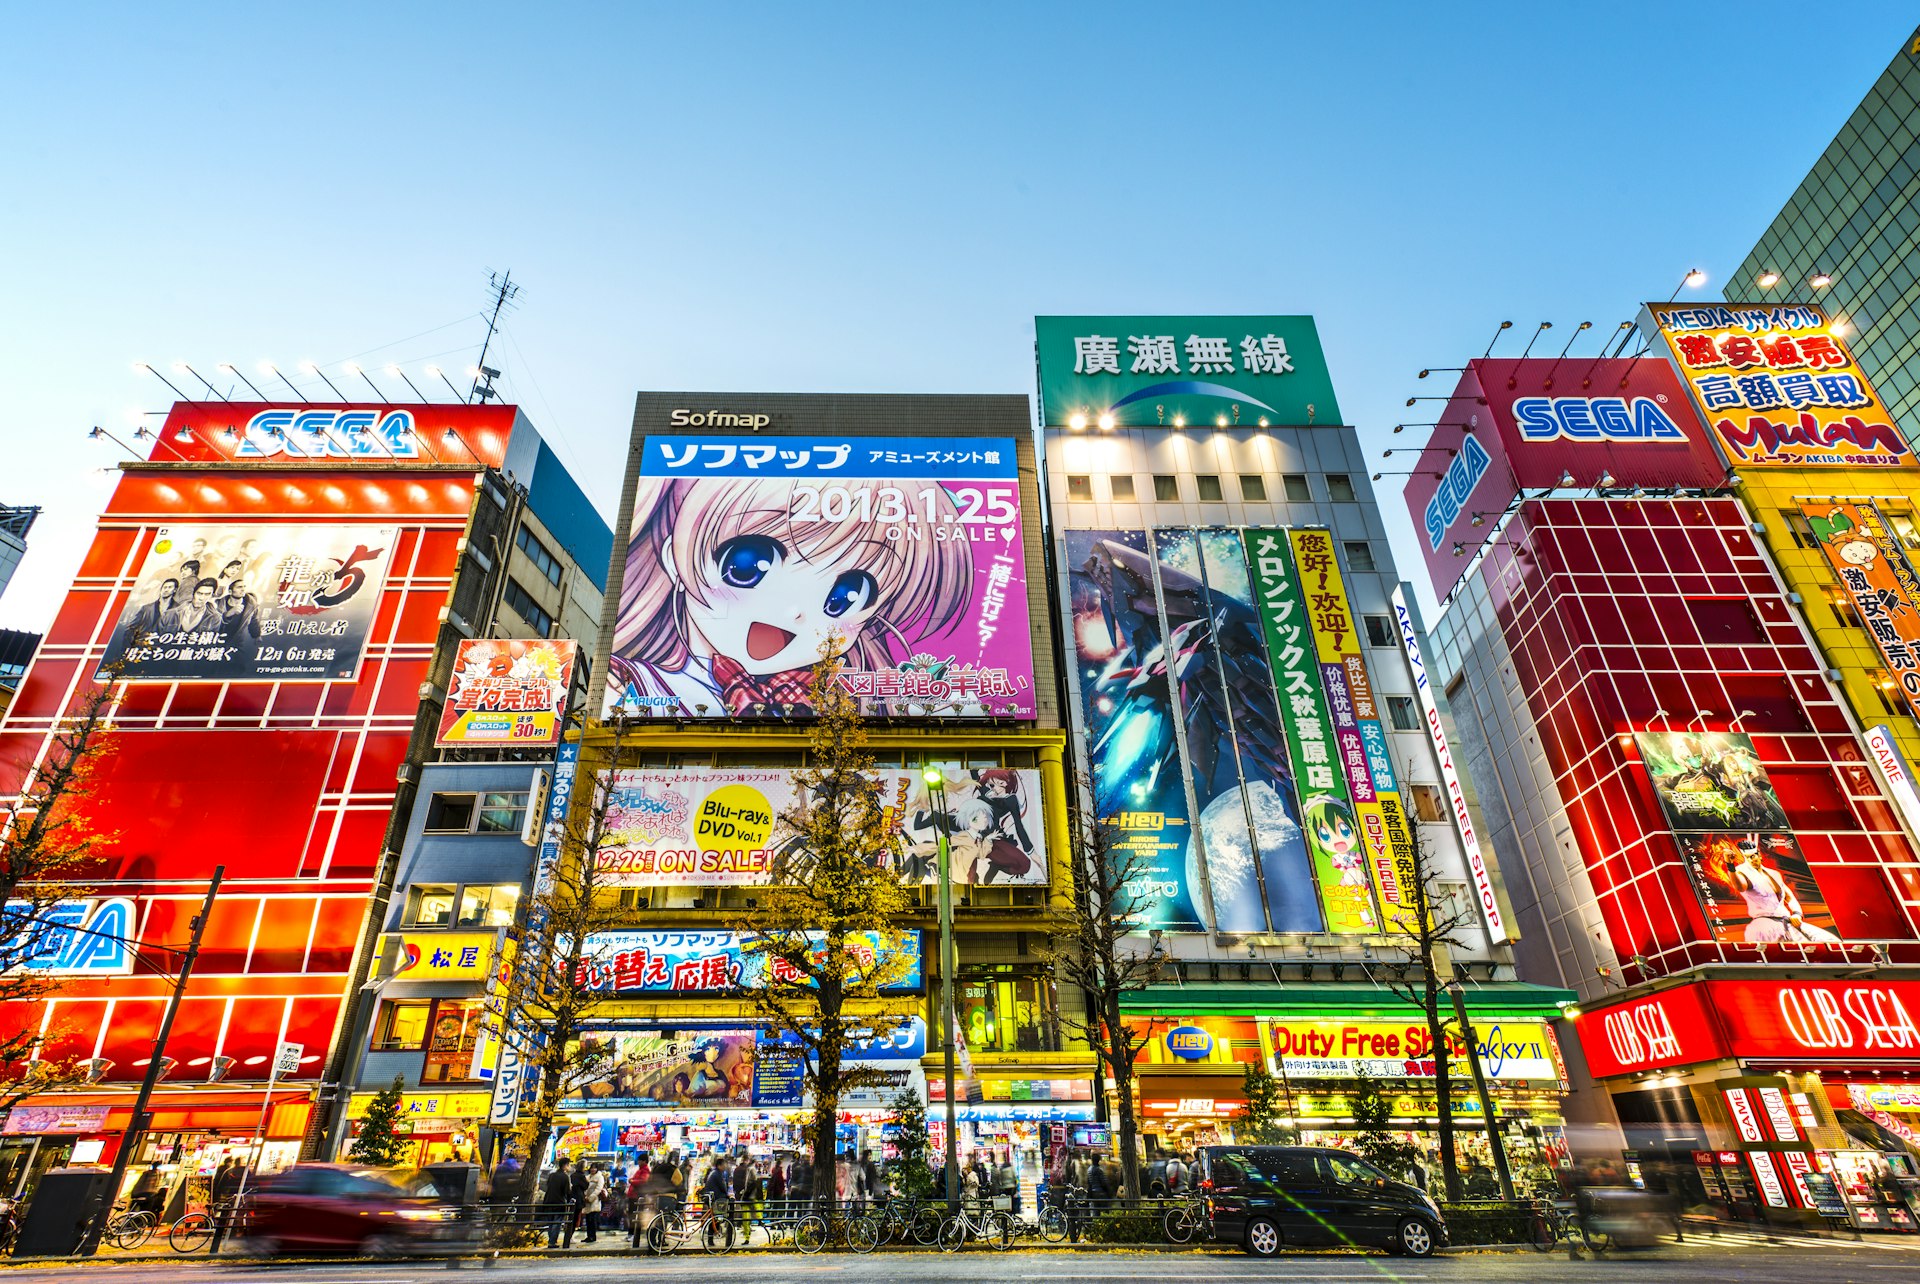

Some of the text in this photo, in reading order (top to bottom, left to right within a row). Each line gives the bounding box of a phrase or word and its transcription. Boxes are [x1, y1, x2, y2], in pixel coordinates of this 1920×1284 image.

[1073, 333, 1295, 376] 廣瀬無線
[1676, 334, 1848, 368] 激安販売
[1692, 372, 1868, 410] 高額買取
[234, 409, 419, 458] SEGA
[671, 409, 770, 432] Sofmap
[1512, 397, 1690, 442] SEGA
[1714, 411, 1910, 460] Mulan
[660, 444, 851, 469] ソフマップ
[869, 451, 1000, 465] アミューズメント館
[1752, 454, 1901, 464] ムーラン AKIBA 中央通り店
[788, 486, 1015, 523] 2013.1.25
[1424, 433, 1493, 553] SEGA
[886, 527, 997, 541] ON SALE
[123, 647, 238, 661] 男たちの血が騒ぐ
[144, 631, 228, 645] その生き様に
[823, 656, 1029, 700] 大図書館の羊飼い
[1256, 535, 1336, 789] メロンブックス秋葉原店
[637, 696, 681, 706] AUGUST
[1326, 666, 1355, 727] 价格优惠
[1345, 656, 1375, 717] 货比三家
[1342, 733, 1372, 800] 优质服务
[1363, 723, 1393, 789] 安心购物
[1396, 604, 1423, 666] AKKY
[1428, 708, 1453, 770] DUTY
[1450, 779, 1475, 846] FREE
[1472, 854, 1499, 928] SHOP
[1871, 736, 1904, 784] GAME
[698, 819, 763, 843] DVD Vol.1
[1119, 812, 1165, 831] Hey
[658, 850, 697, 873] ON
[701, 850, 774, 873] SALE!
[1364, 814, 1402, 904] DUTY FREE
[1123, 876, 1178, 898] TAITO
[1324, 884, 1369, 898] このビル
[430, 946, 479, 968] 松屋
[653, 933, 733, 947] ソフマップ
[1604, 1010, 1645, 1066] CLUB
[1634, 1001, 1683, 1061] SEGA
[1779, 988, 1920, 1049] CLUB SEGA
[1172, 1034, 1209, 1050] Hey
[1276, 1026, 1335, 1057] Duty
[1342, 1027, 1400, 1056] Free
[1476, 1042, 1526, 1059] AKKY
[410, 1099, 437, 1112] 松屋
[1178, 1099, 1214, 1113] Hey
[1732, 1089, 1757, 1141] GAME
[1762, 1091, 1796, 1141] CLUB SEGA
[1755, 1155, 1784, 1206] CLUB SEGA
